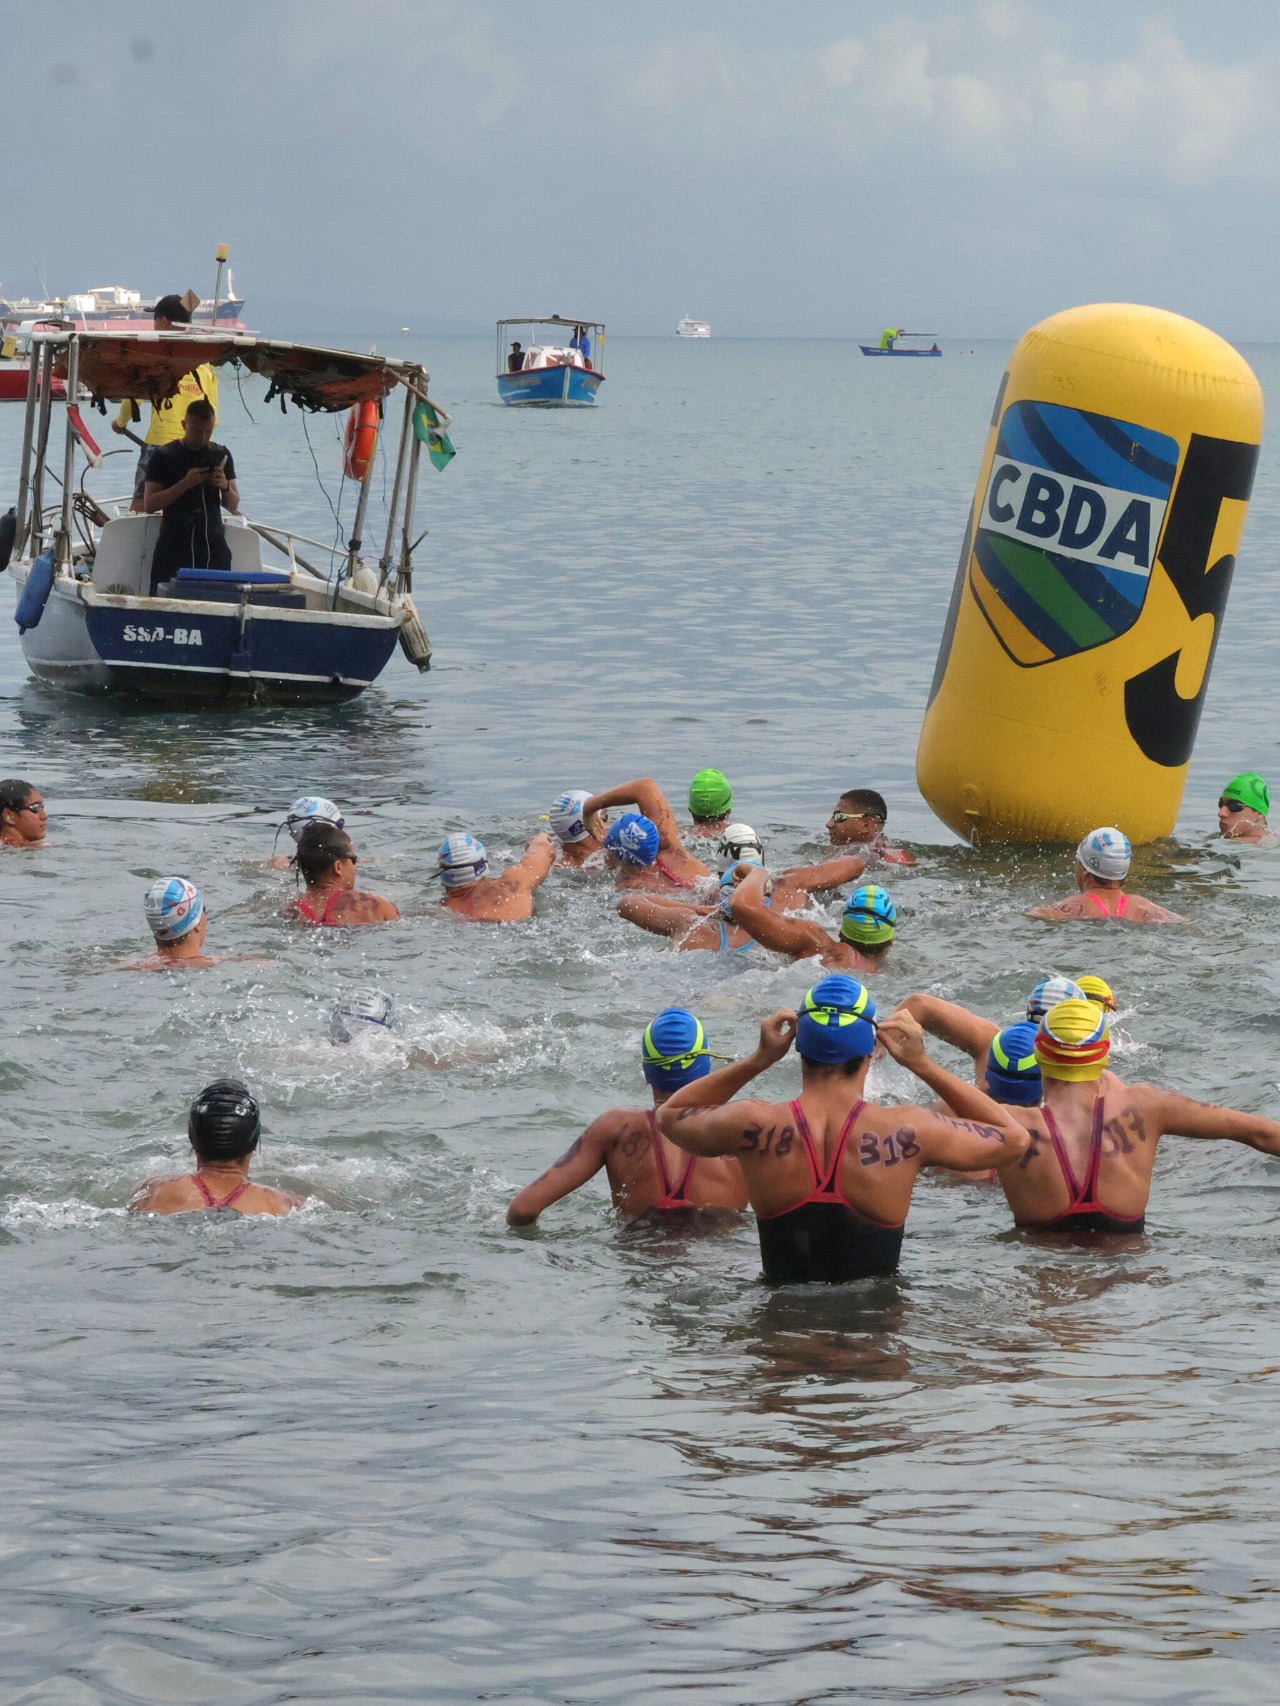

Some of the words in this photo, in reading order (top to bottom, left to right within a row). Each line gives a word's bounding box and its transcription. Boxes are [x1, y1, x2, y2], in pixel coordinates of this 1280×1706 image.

[988, 463, 1151, 569] CBDA
[122, 624, 203, 646] SSA-BA
[1124, 432, 1261, 768] 5
[859, 1125, 922, 1168] 318
